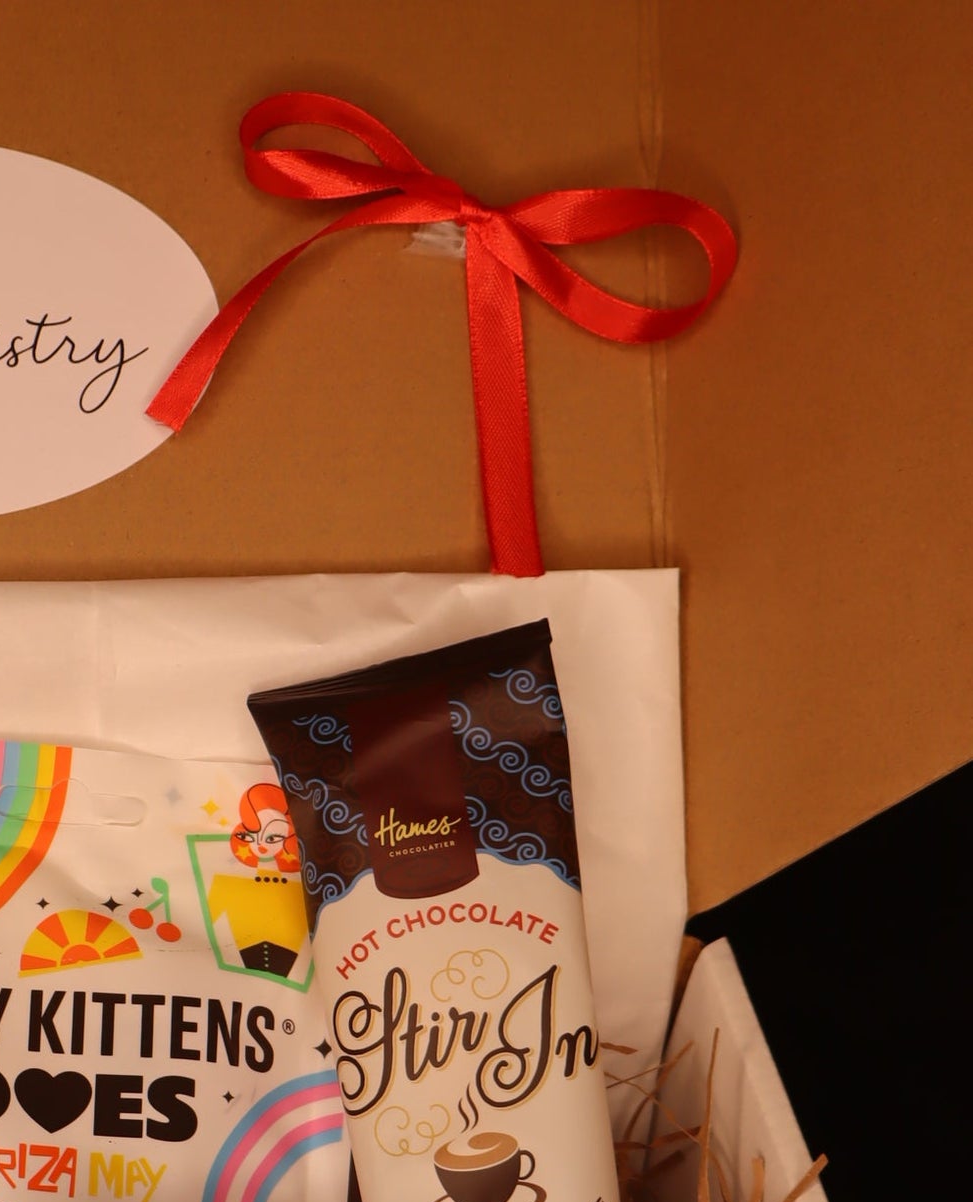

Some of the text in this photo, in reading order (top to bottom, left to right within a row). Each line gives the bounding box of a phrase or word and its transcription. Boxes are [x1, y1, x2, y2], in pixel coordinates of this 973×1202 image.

[374, 808, 461, 847] Hames
[388, 840, 455, 858] CHOCOLATIER
[335, 902, 559, 980] HOT CHOCOLATE
[333, 963, 600, 1116] Stir In
